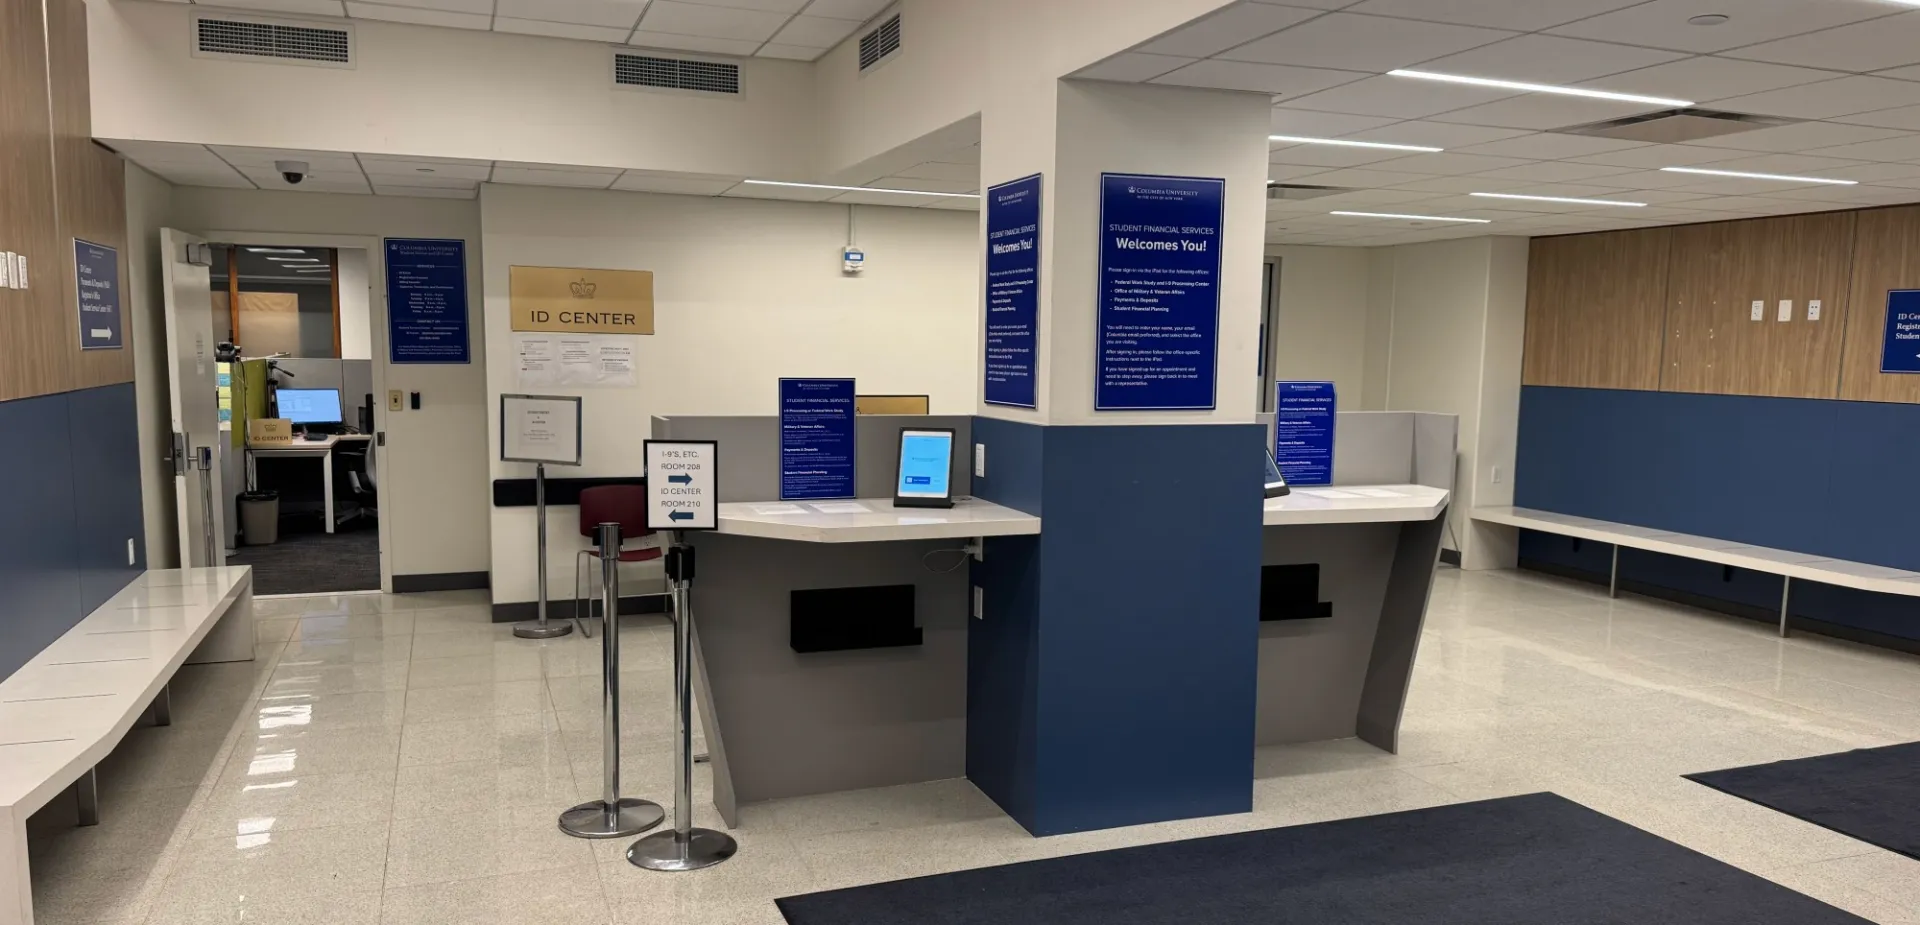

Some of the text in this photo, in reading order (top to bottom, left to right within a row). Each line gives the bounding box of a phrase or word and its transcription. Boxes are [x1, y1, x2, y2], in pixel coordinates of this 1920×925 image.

[990, 224, 1036, 239] STUDENT FINANCIAL SERVICES
[1110, 224, 1142, 232] STUDENT
[1144, 225, 1179, 233] FINANCIAL
[993, 238, 1032, 254] Welcomes You!
[1116, 237, 1206, 251] Welcomes You!
[532, 311, 635, 325] ID CENTER
